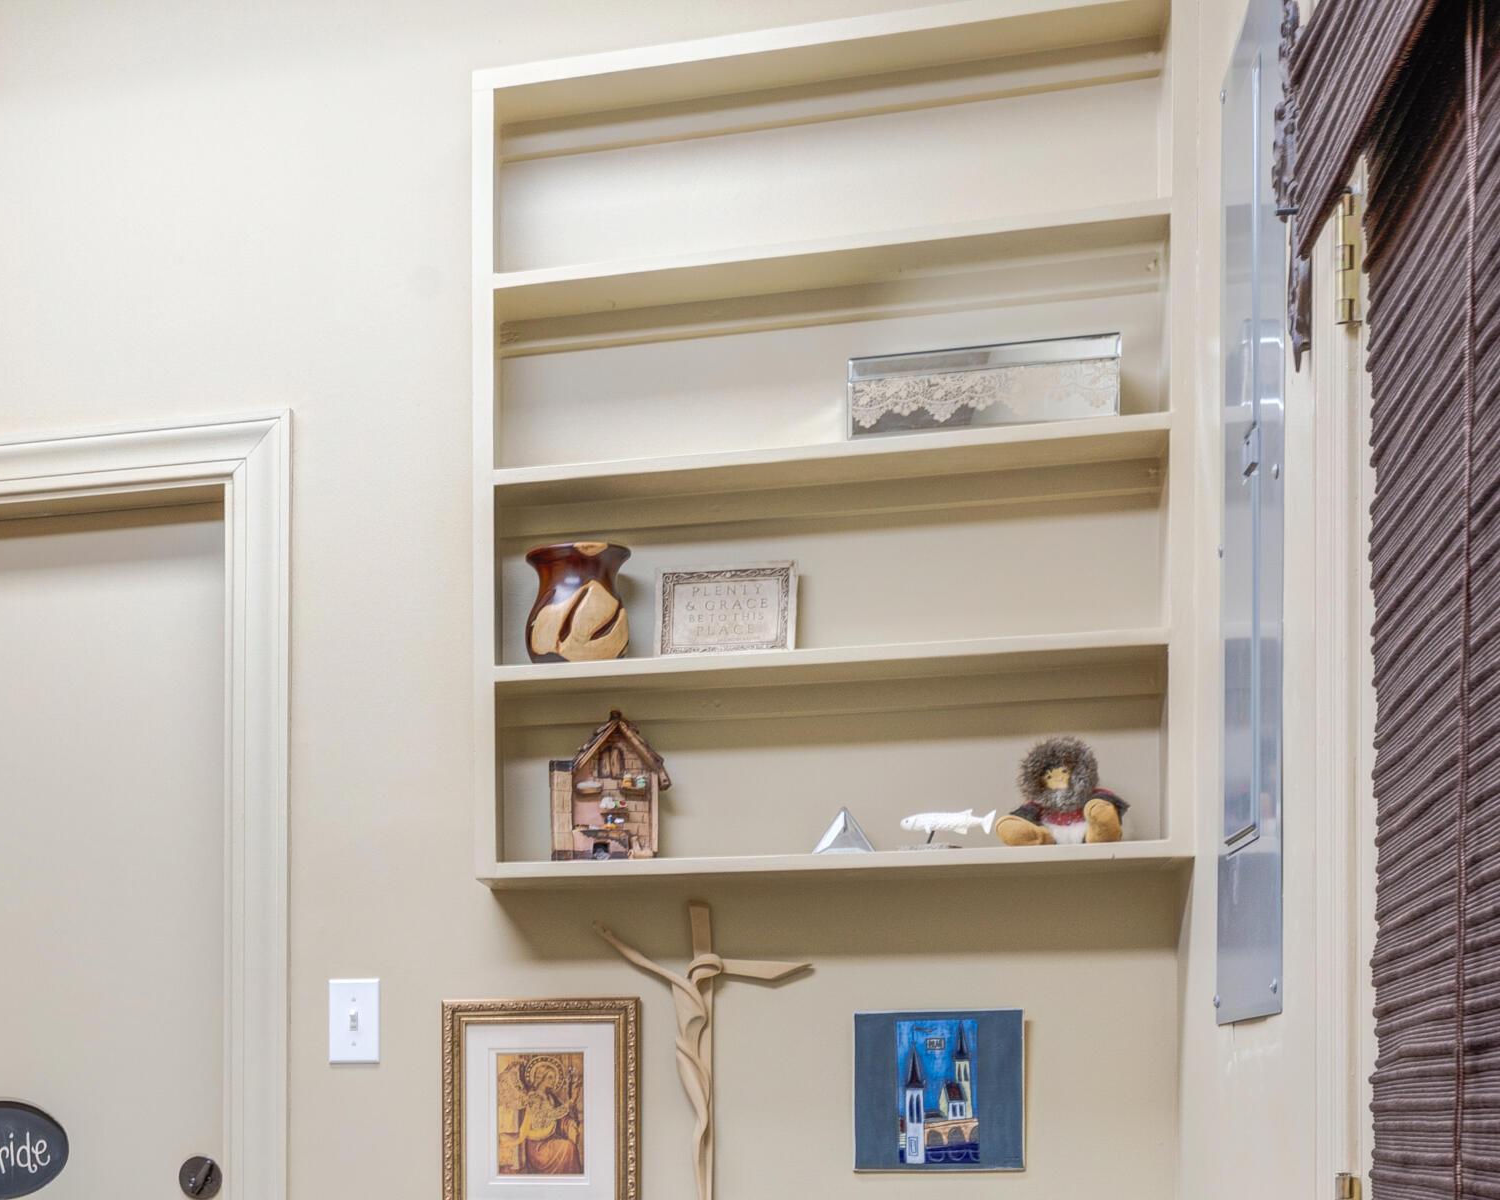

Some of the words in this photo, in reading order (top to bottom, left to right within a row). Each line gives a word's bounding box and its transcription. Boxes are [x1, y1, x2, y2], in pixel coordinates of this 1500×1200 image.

[692, 583, 764, 597] PLENTY
[685, 601, 695, 611] &
[705, 599, 769, 611] GRACE
[733, 611, 764, 622] THIS
[697, 625, 755, 636] PLACE
